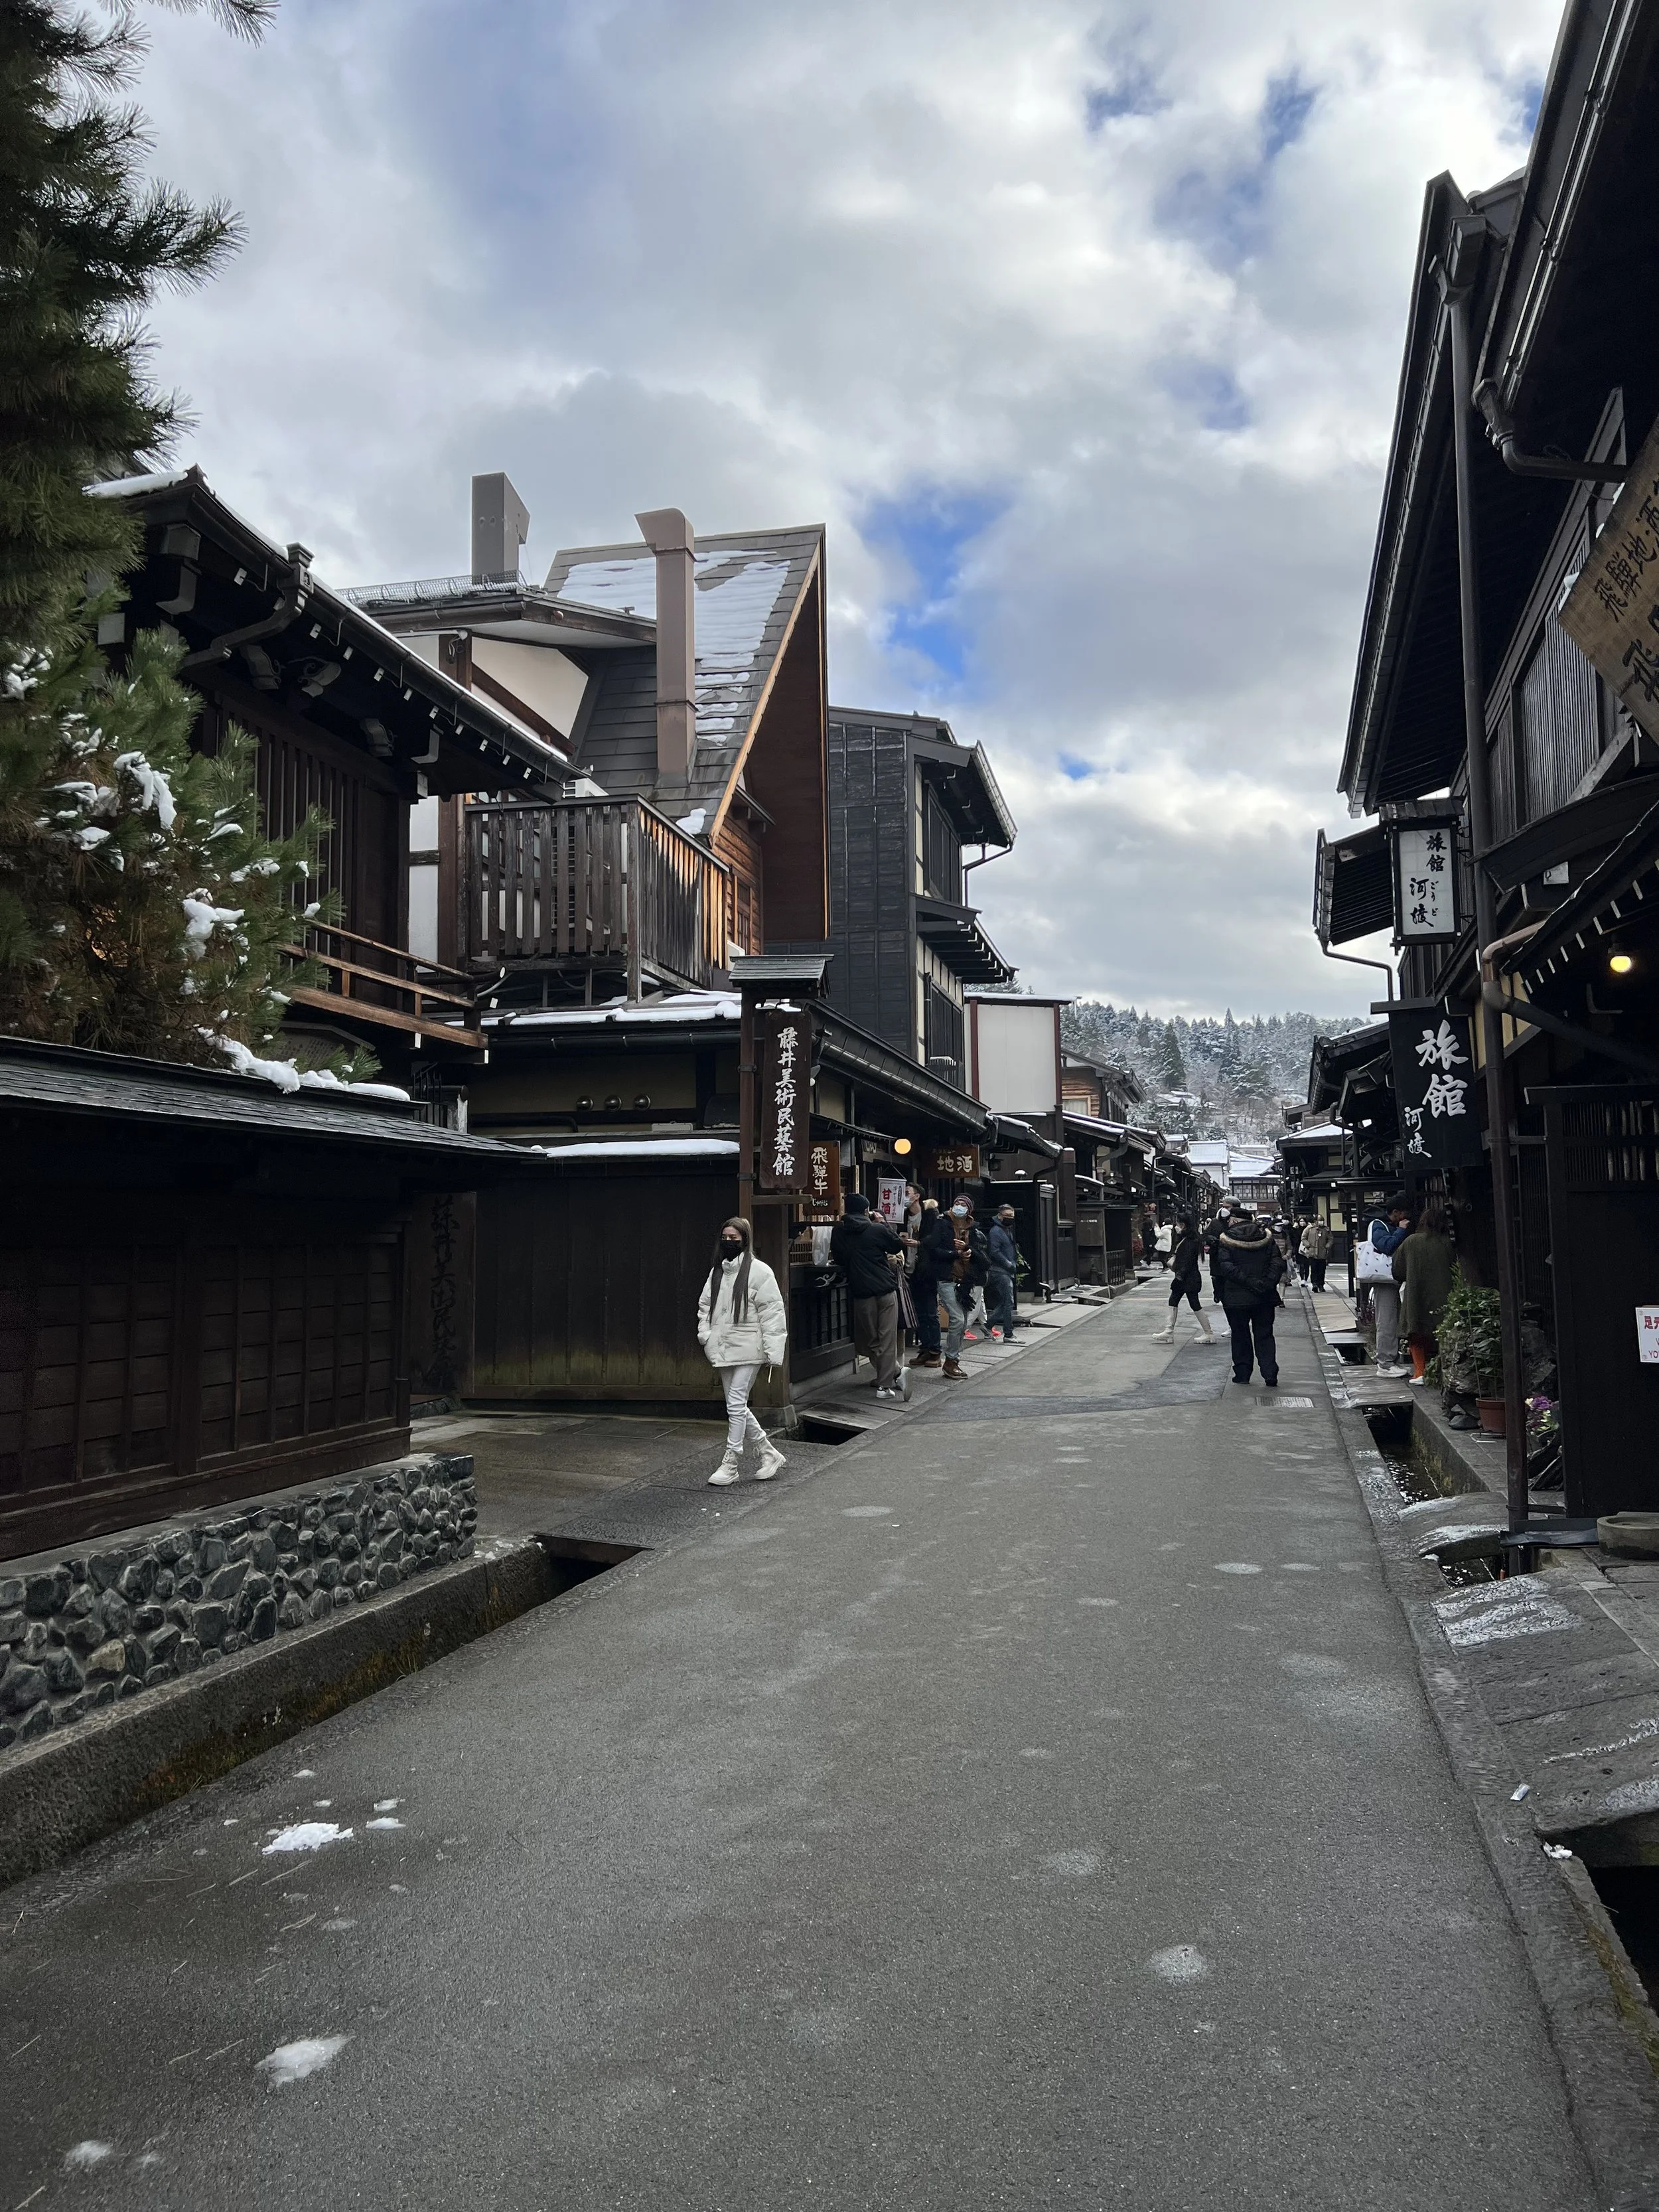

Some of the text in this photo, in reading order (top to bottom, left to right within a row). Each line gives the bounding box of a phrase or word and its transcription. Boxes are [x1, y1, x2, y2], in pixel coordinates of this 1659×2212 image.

[1426, 833, 1447, 872] 旅館
[1430, 880, 1439, 917] ごうど
[1415, 1019, 1469, 1118] 旅館
[772, 1027, 799, 1177] 藤井美術民藝館
[810, 1146, 829, 1196] 飛騨牛
[937, 1155, 973, 1173] 地酒
[881, 1188, 892, 1215] 甘酒
